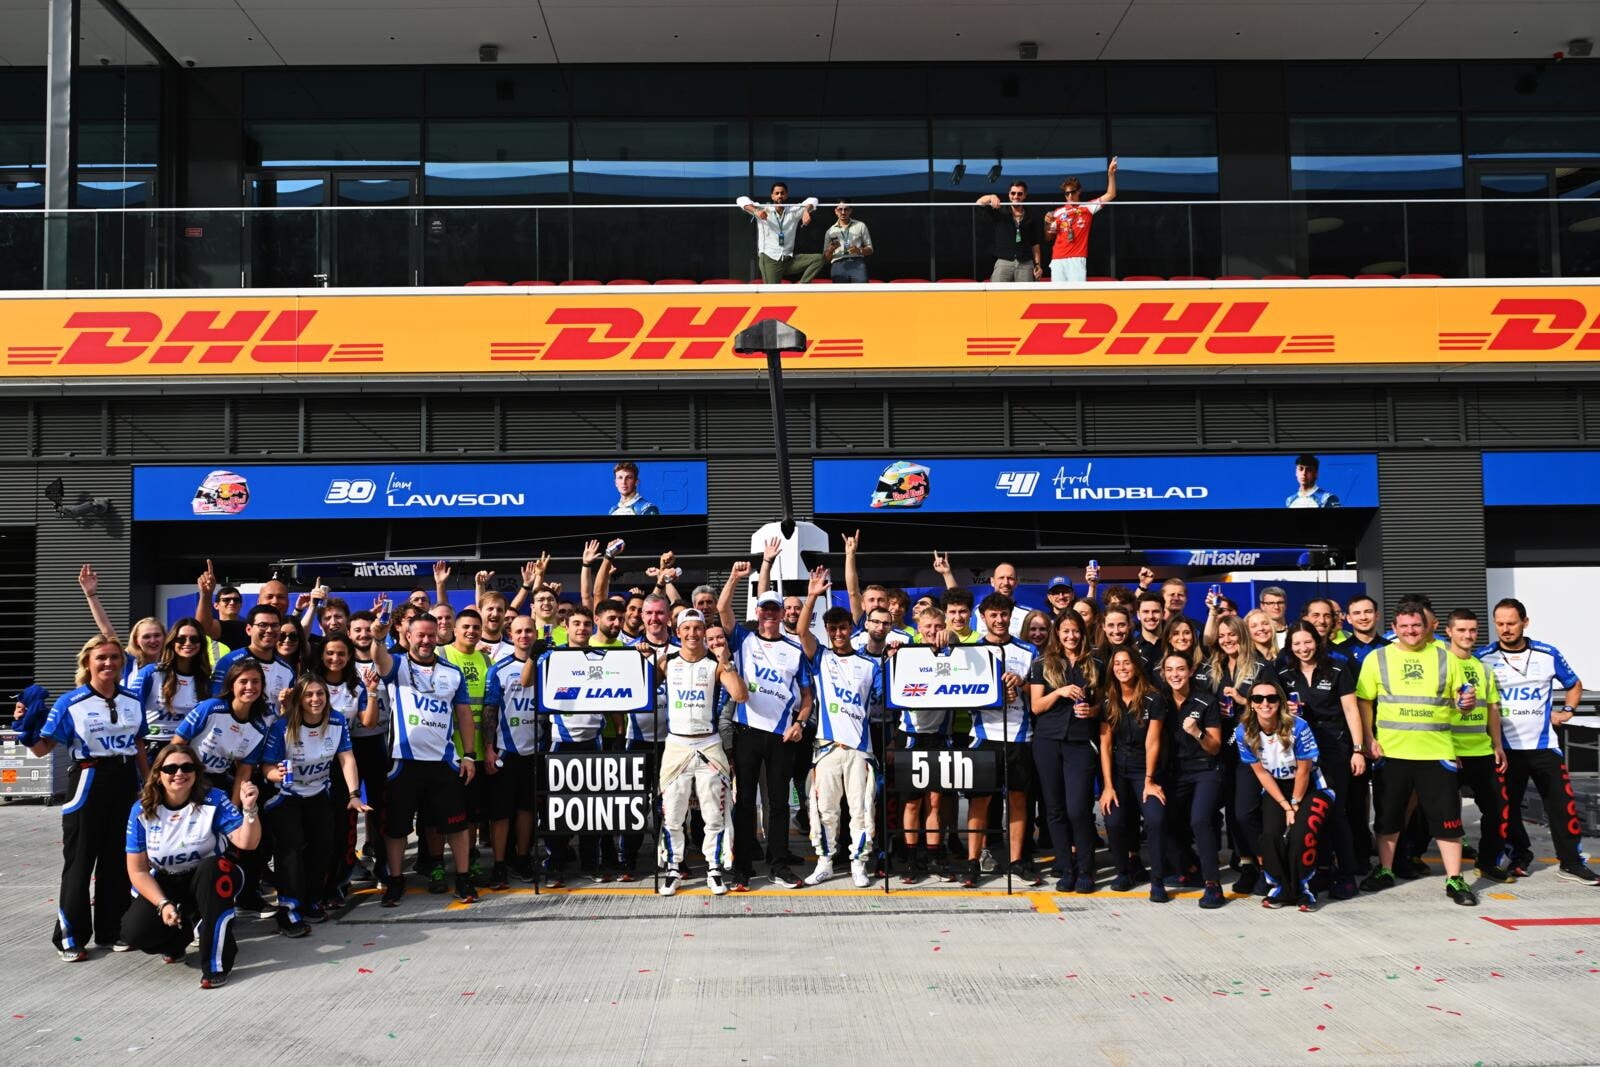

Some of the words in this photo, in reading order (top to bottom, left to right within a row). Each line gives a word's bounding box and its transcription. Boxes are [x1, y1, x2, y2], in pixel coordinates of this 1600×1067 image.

[1015, 302, 1286, 355] DHL
[57, 310, 334, 365] DHL
[386, 472, 412, 494] Liam
[1052, 462, 1092, 490] Arvid
[324, 479, 377, 504] 30
[1056, 486, 1208, 500] LINDBLAD
[388, 493, 524, 507] LAWSON
[1188, 550, 1260, 566] Airtasker
[354, 562, 417, 577] Airtasker
[585, 687, 633, 699] LIAM
[677, 690, 705, 701] VISA
[934, 683, 990, 695] ARVID
[1499, 687, 1541, 701] VISA
[412, 693, 448, 714] VISA
[511, 697, 535, 711] VIS
[1398, 707, 1434, 718] Airtasker
[1460, 713, 1484, 721] Airtas
[1512, 708, 1530, 716] Cash
[1531, 708, 1544, 716] App
[421, 719, 437, 728] Cash
[96, 733, 137, 750] VISA
[296, 760, 332, 776] VISA
[548, 757, 645, 792] DOUBLE
[911, 750, 930, 789] 5
[938, 750, 974, 789] th
[548, 796, 645, 832] POINTS
[1302, 796, 1329, 867] HUGO
[152, 850, 201, 866] VISA
